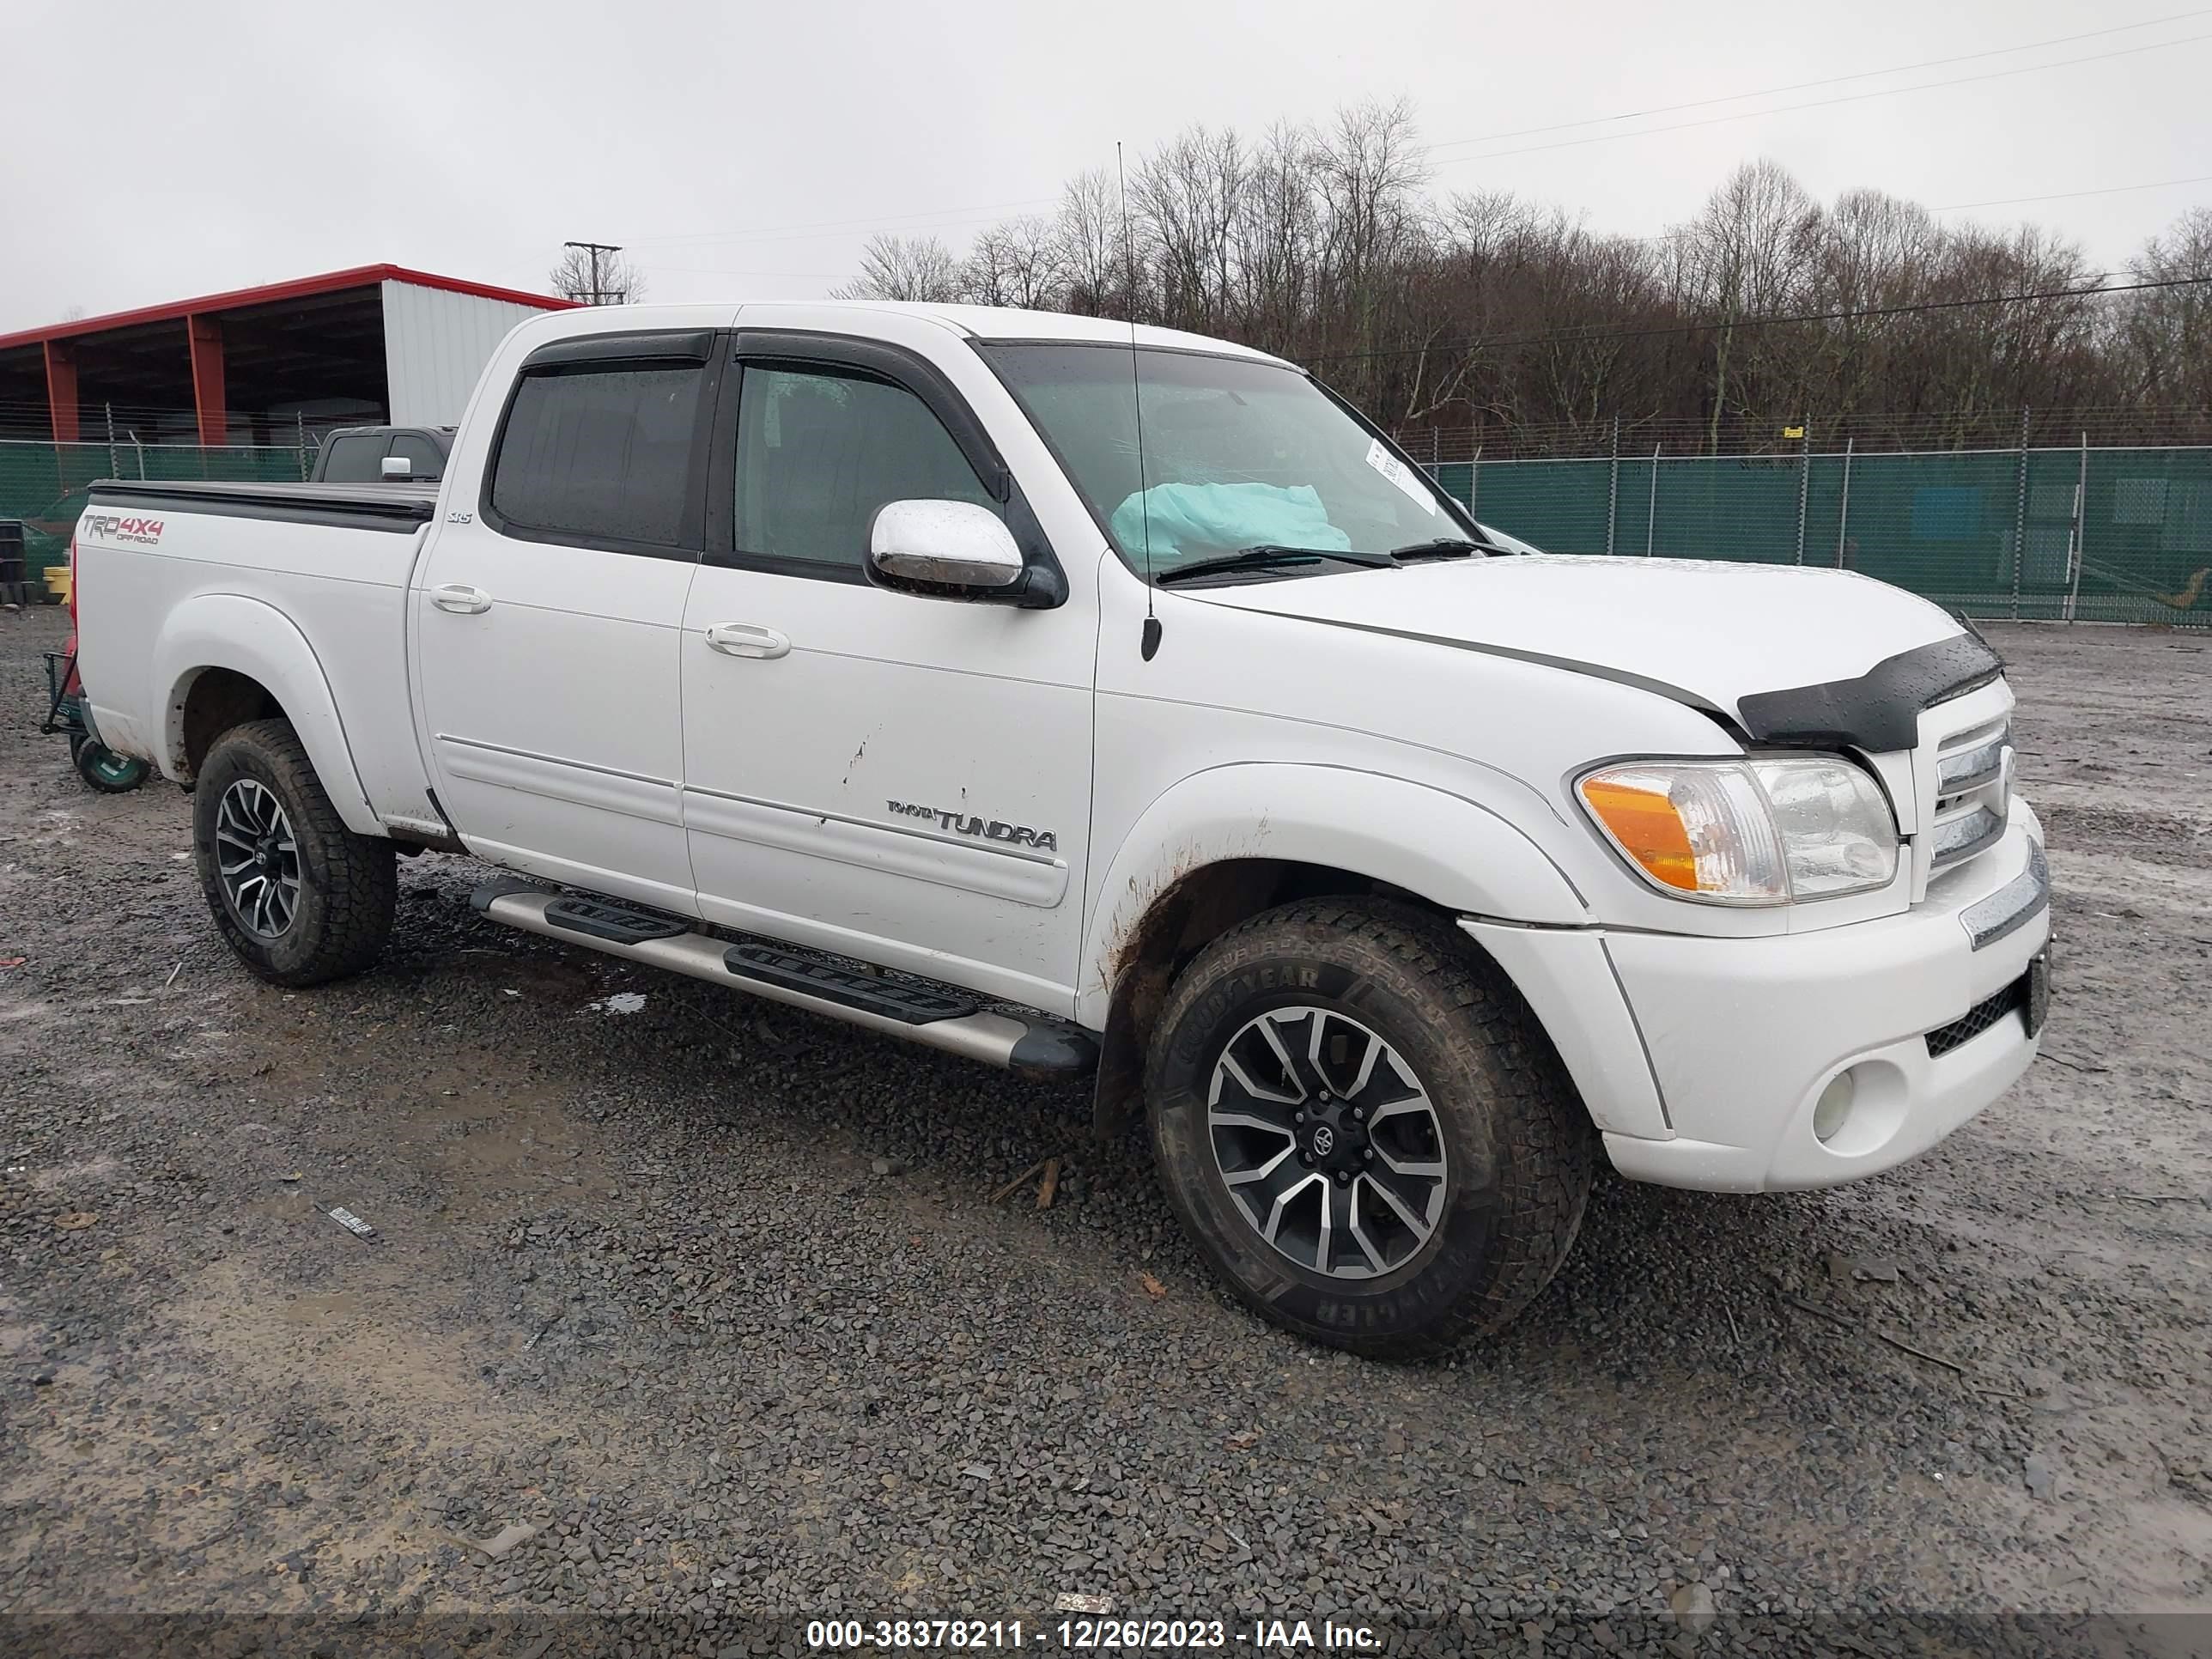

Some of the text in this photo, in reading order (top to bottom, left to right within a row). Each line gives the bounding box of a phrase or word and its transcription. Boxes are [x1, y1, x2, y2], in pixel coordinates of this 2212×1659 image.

[83, 514, 165, 540] TRD 4X4
[116, 533, 159, 545] OFF ROAD
[885, 799, 1058, 852] TOYOTA TUNDRA
[1178, 965, 1320, 1066] GOODYEAR
